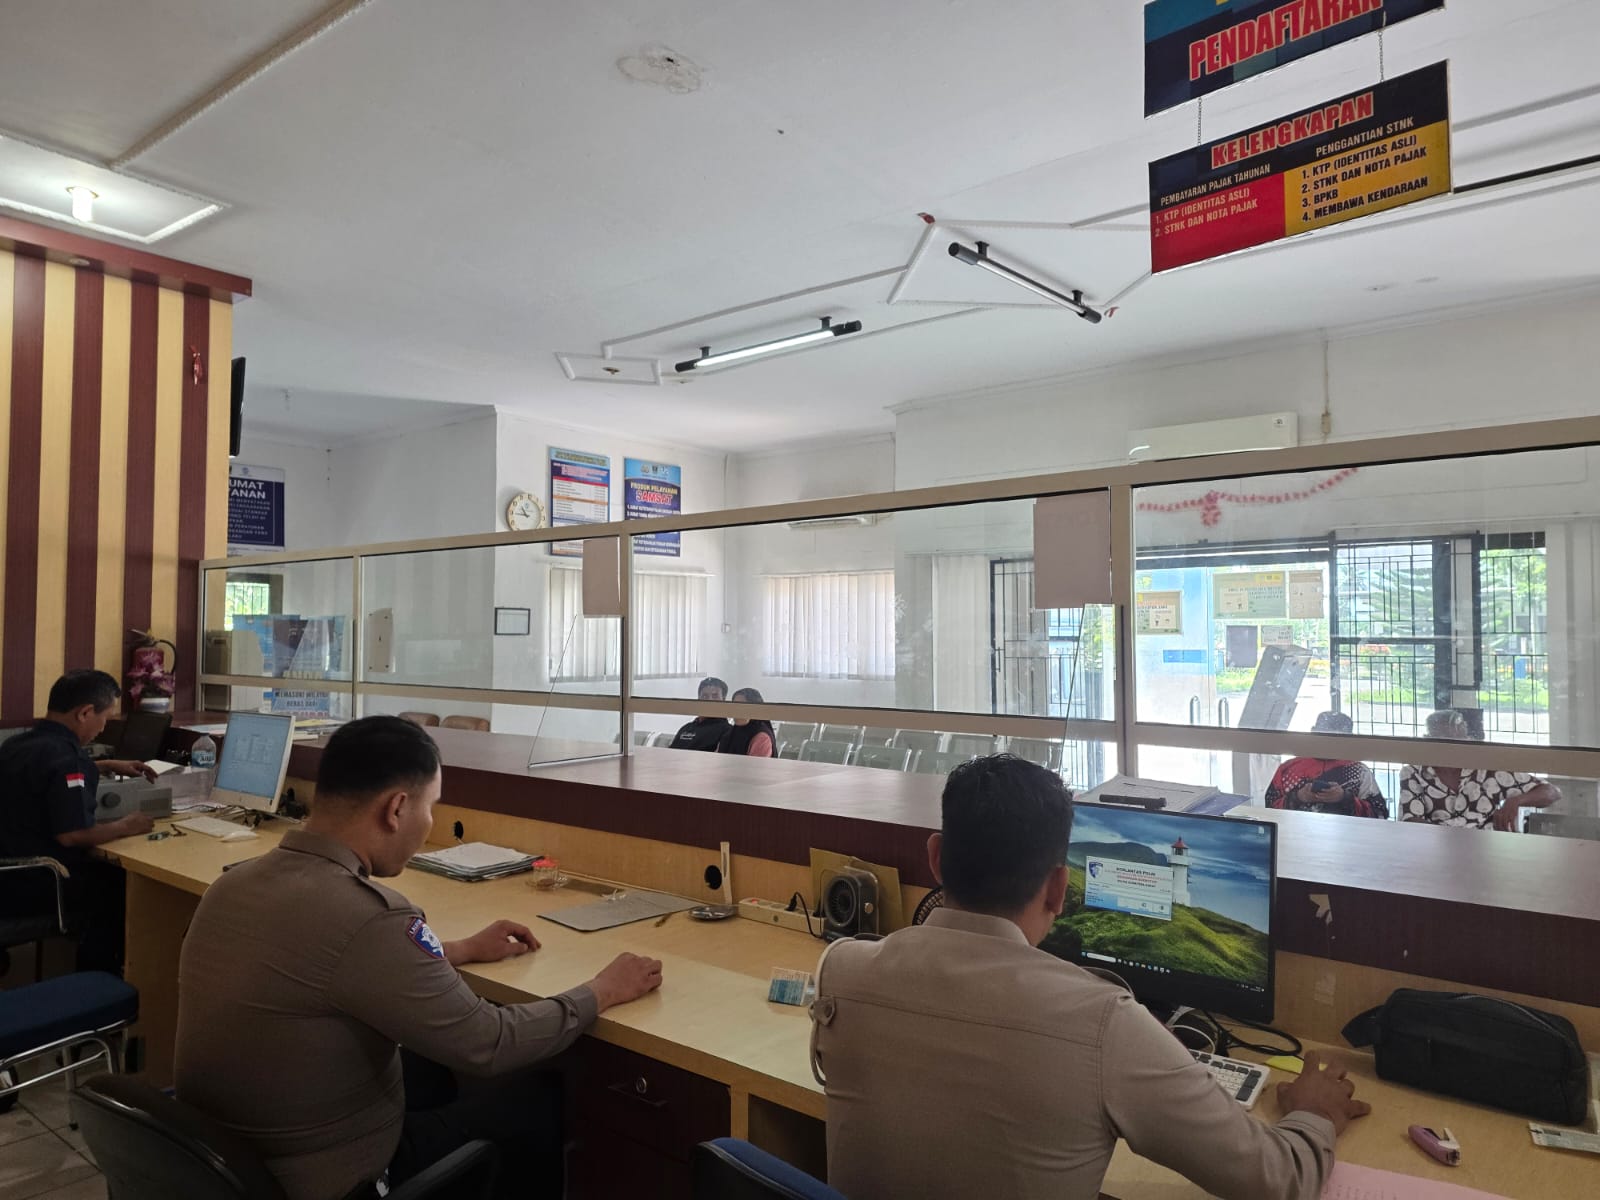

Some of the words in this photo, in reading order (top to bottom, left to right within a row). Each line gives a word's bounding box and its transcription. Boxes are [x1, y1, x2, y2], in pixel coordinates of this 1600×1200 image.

[1189, 0, 1383, 81] PENDAFTARA
[1211, 91, 1374, 170] KELENGKAPAN
[1316, 128, 1383, 157] PENGGANTIAN
[1386, 116, 1414, 134] STNK
[1301, 183, 1310, 194] 2.
[1313, 175, 1338, 190] STNK
[1341, 168, 1361, 182] DAN
[1364, 158, 1391, 175] NOTA
[1394, 147, 1427, 165] PAJAK
[1302, 170, 1310, 179] 1.
[1312, 163, 1331, 177] KTP
[1334, 144, 1388, 170] (IDENTITAS
[1391, 134, 1417, 151] ASLI)
[1160, 184, 1207, 206] PEMBAYARAN
[1209, 176, 1232, 191] PAJAK
[1234, 163, 1271, 183] TAHUNAN
[1163, 209, 1179, 222] KTP
[1181, 195, 1226, 217] (IDENTITAS
[1228, 187, 1250, 202] ASLI)
[1302, 198, 1311, 208] 3.
[1314, 189, 1338, 205] BPKB
[1302, 212, 1311, 222] 4.
[1314, 196, 1365, 219] MEMBAWA
[1367, 176, 1428, 203] KENDARAAN
[1164, 221, 1186, 234] STNK
[1187, 215, 1204, 228] DAN
[1206, 208, 1228, 222] NOTA
[1230, 198, 1258, 214] PAJAK
[229, 488, 266, 500] ANAN
[635, 490, 673, 505] SAMSAT
